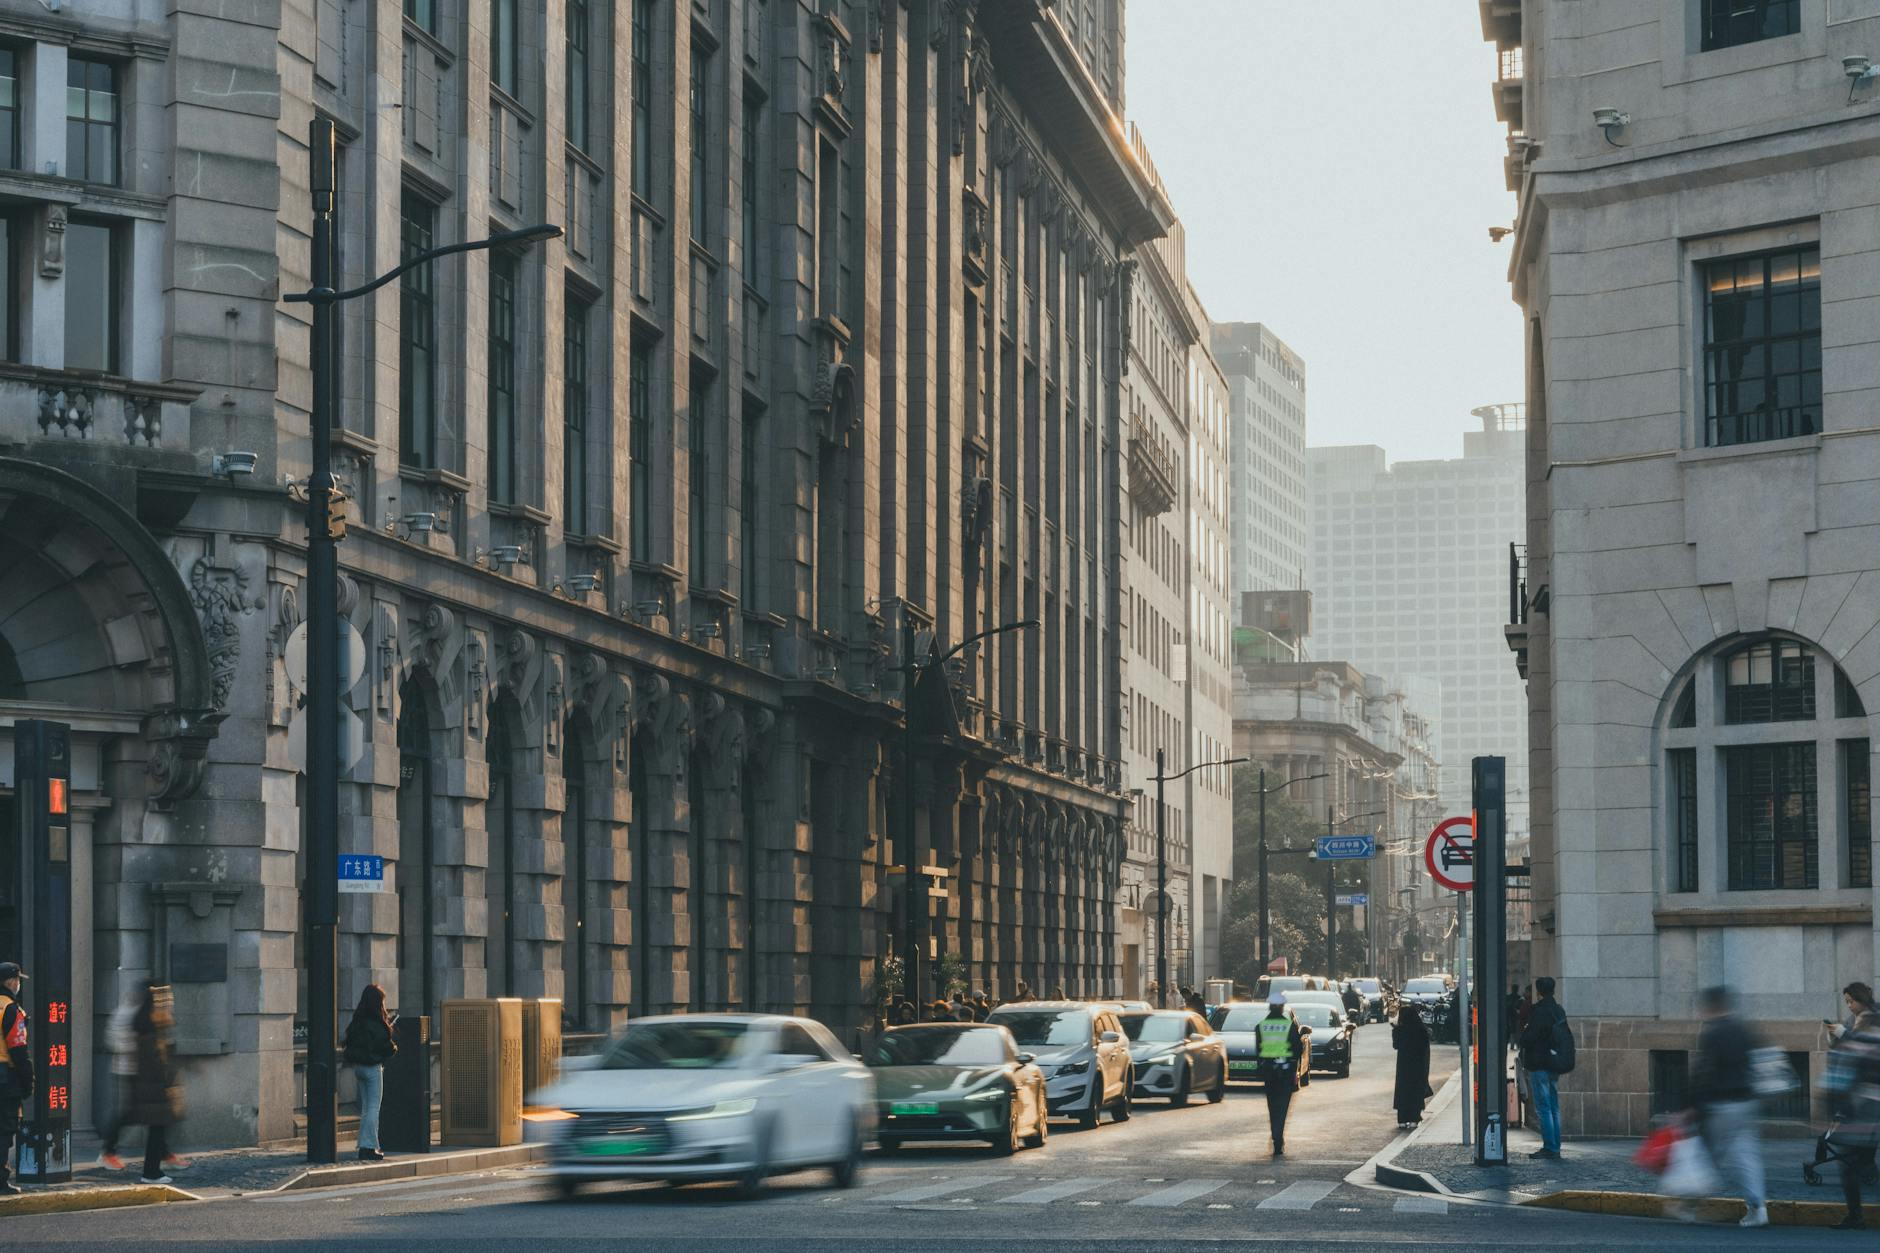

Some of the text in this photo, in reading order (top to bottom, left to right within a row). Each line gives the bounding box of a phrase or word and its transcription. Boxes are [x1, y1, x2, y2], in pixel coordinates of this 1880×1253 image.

[344, 859, 371, 876] 广东路
[49, 1002, 68, 1024] 遵守
[49, 1045, 67, 1067] 交通
[49, 1086, 68, 1109] 信号
